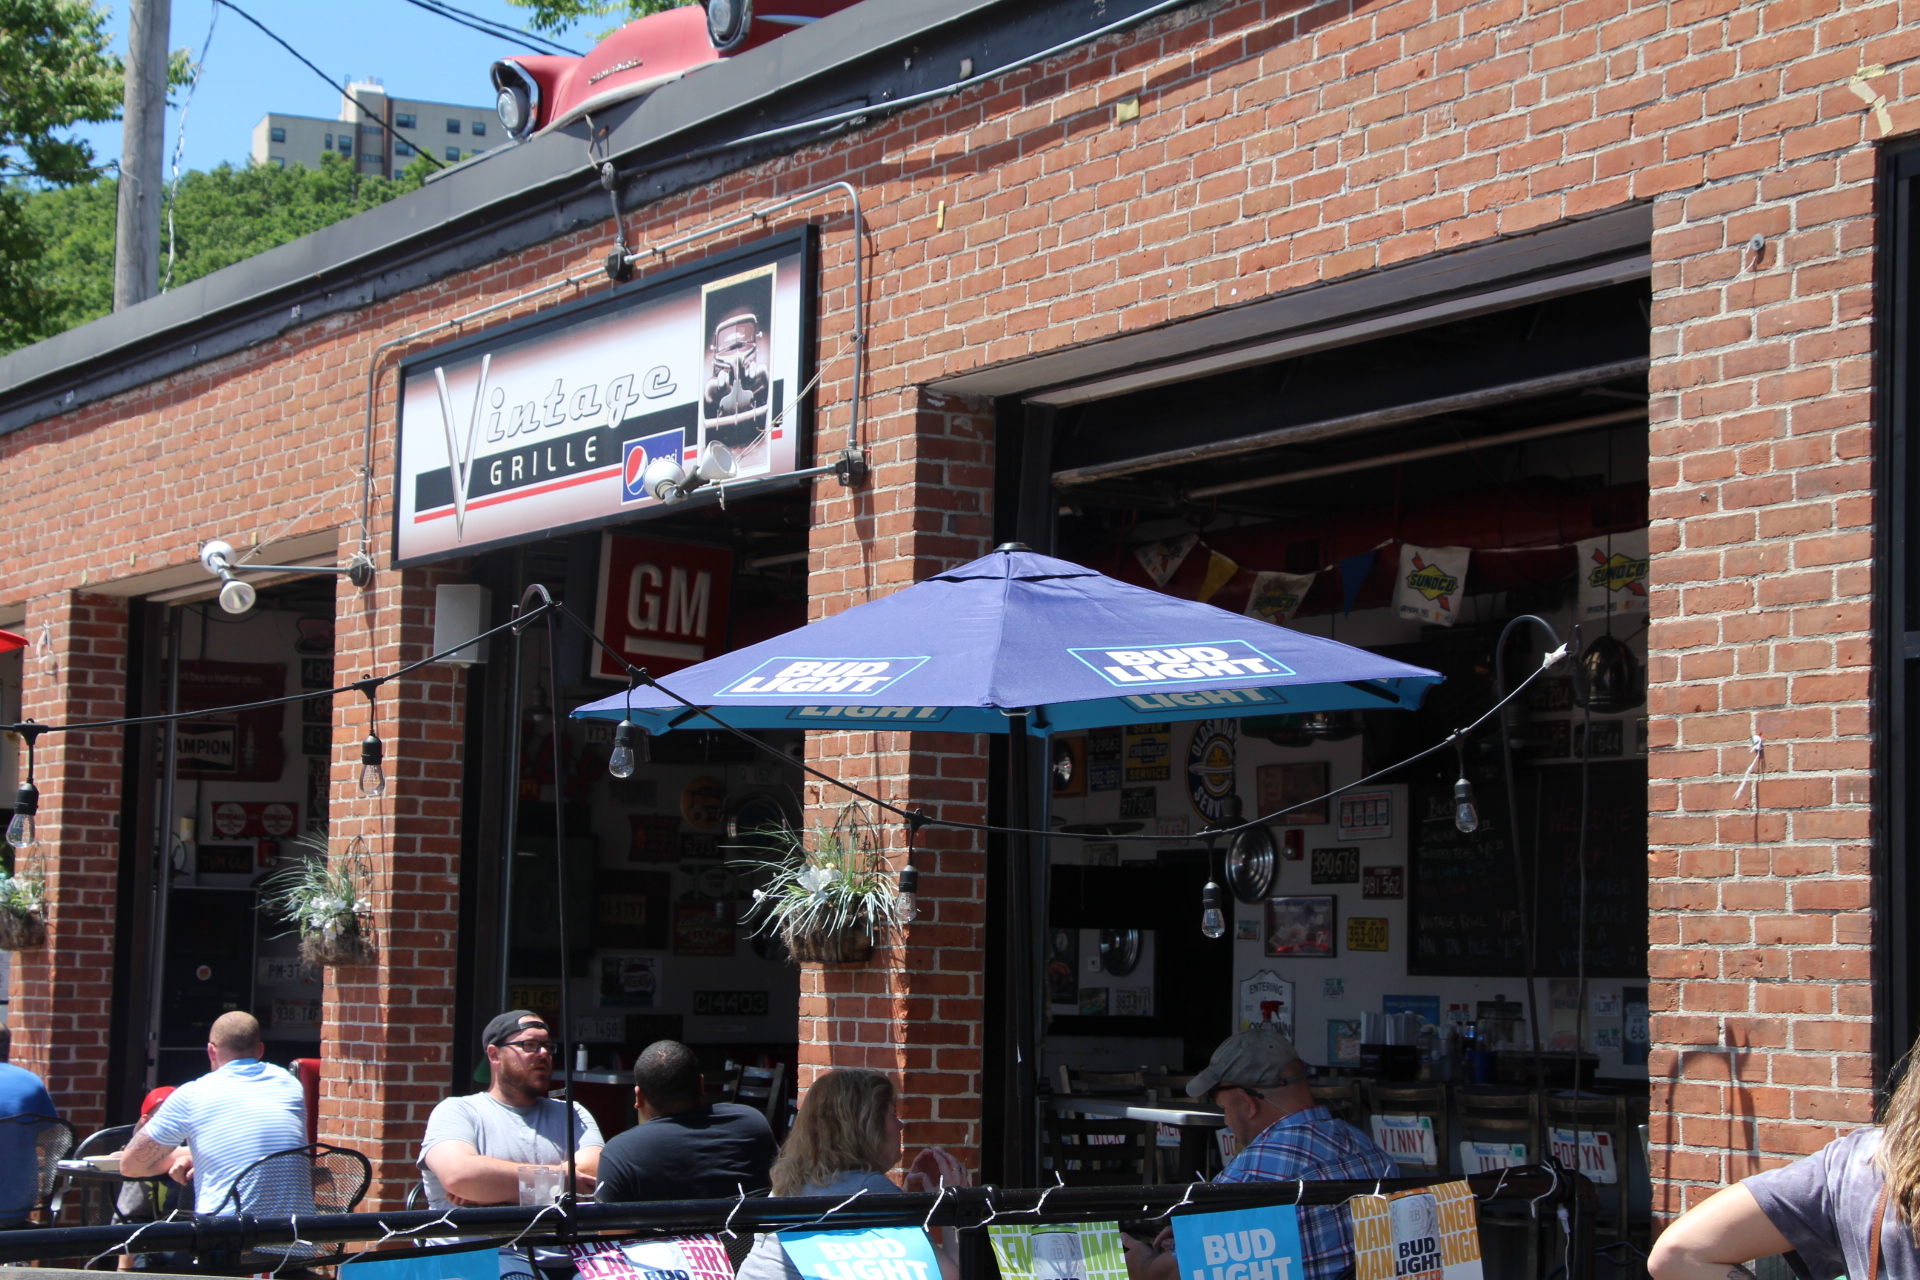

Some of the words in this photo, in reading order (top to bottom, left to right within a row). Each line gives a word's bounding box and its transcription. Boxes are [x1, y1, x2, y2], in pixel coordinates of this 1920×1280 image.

[434, 353, 678, 543] Vintage
[490, 436, 597, 486] GRILLE
[1408, 574, 1456, 593] SUNOCO
[1592, 562, 1648, 583] SUNOCO
[627, 562, 712, 638] GM
[1104, 646, 1237, 668] BUD
[775, 661, 890, 677] BUD
[1103, 656, 1269, 683] LIGHT
[729, 676, 892, 693] LIGHT
[1128, 767, 1168, 780] SERVICE
[1249, 981, 1284, 996] ENTERING
[1630, 1025, 1646, 1040] 66
[1379, 1128, 1425, 1153] VINNY
[817, 1238, 907, 1262] BUD
[1201, 1228, 1277, 1266] BUD
[1398, 1237, 1437, 1259] BUD
[813, 1258, 929, 1280] LIGHT
[1192, 1256, 1293, 1280] LIGHT
[1395, 1252, 1442, 1277] LIGHT
